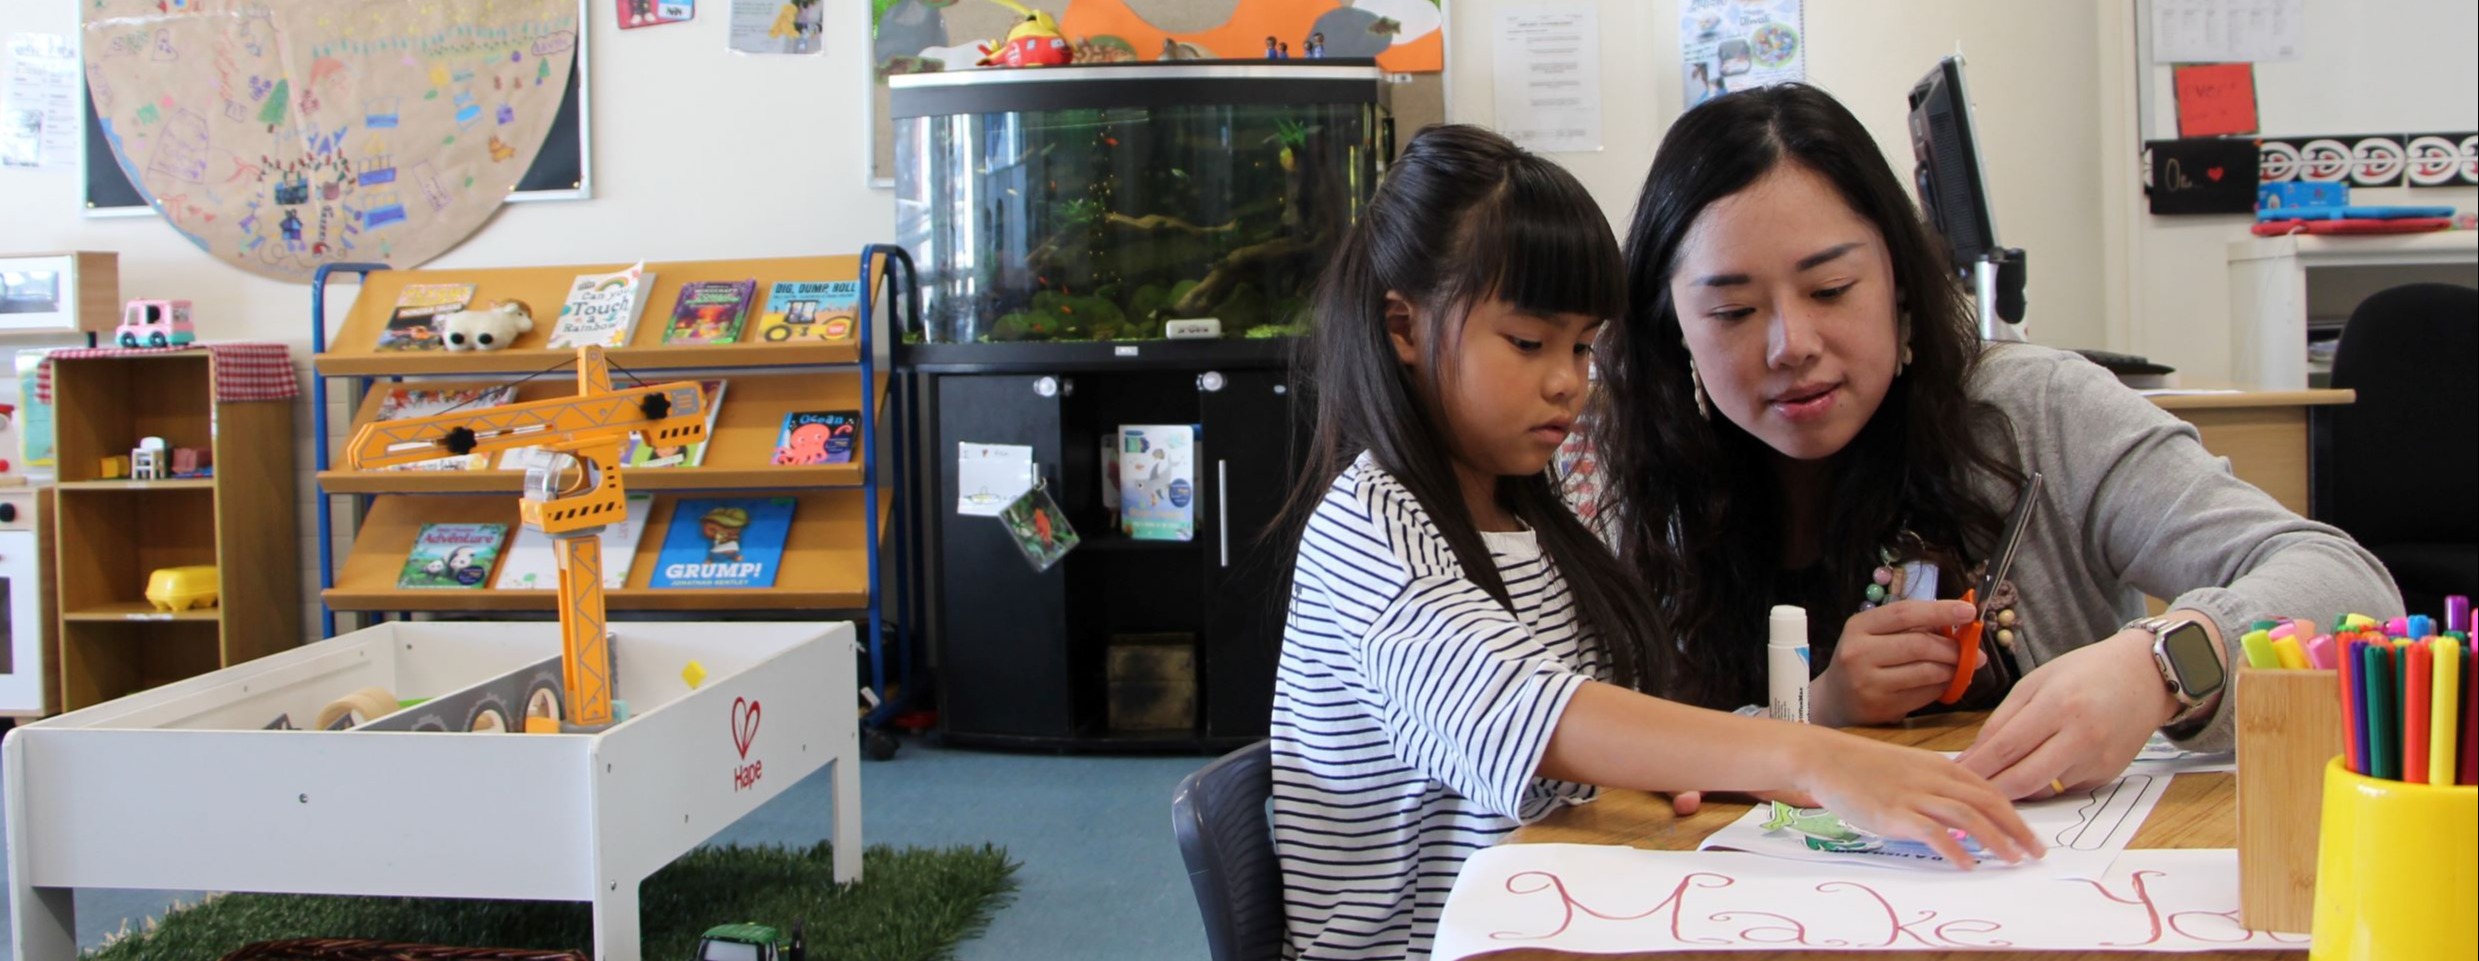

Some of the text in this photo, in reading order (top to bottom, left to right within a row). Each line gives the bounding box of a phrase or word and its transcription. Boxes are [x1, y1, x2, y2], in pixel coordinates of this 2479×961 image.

[1740, 14, 1771, 26] Diwali
[832, 282, 856, 293] ROLL
[582, 288, 630, 300] Can you
[573, 295, 629, 316] Touch
[586, 315, 596, 324] a
[800, 414, 844, 425] Ocean
[425, 532, 495, 544] Adventure
[665, 562, 763, 579] GRUMP!
[734, 759, 762, 792] Hape
[1489, 870, 2311, 947] Make Yo
